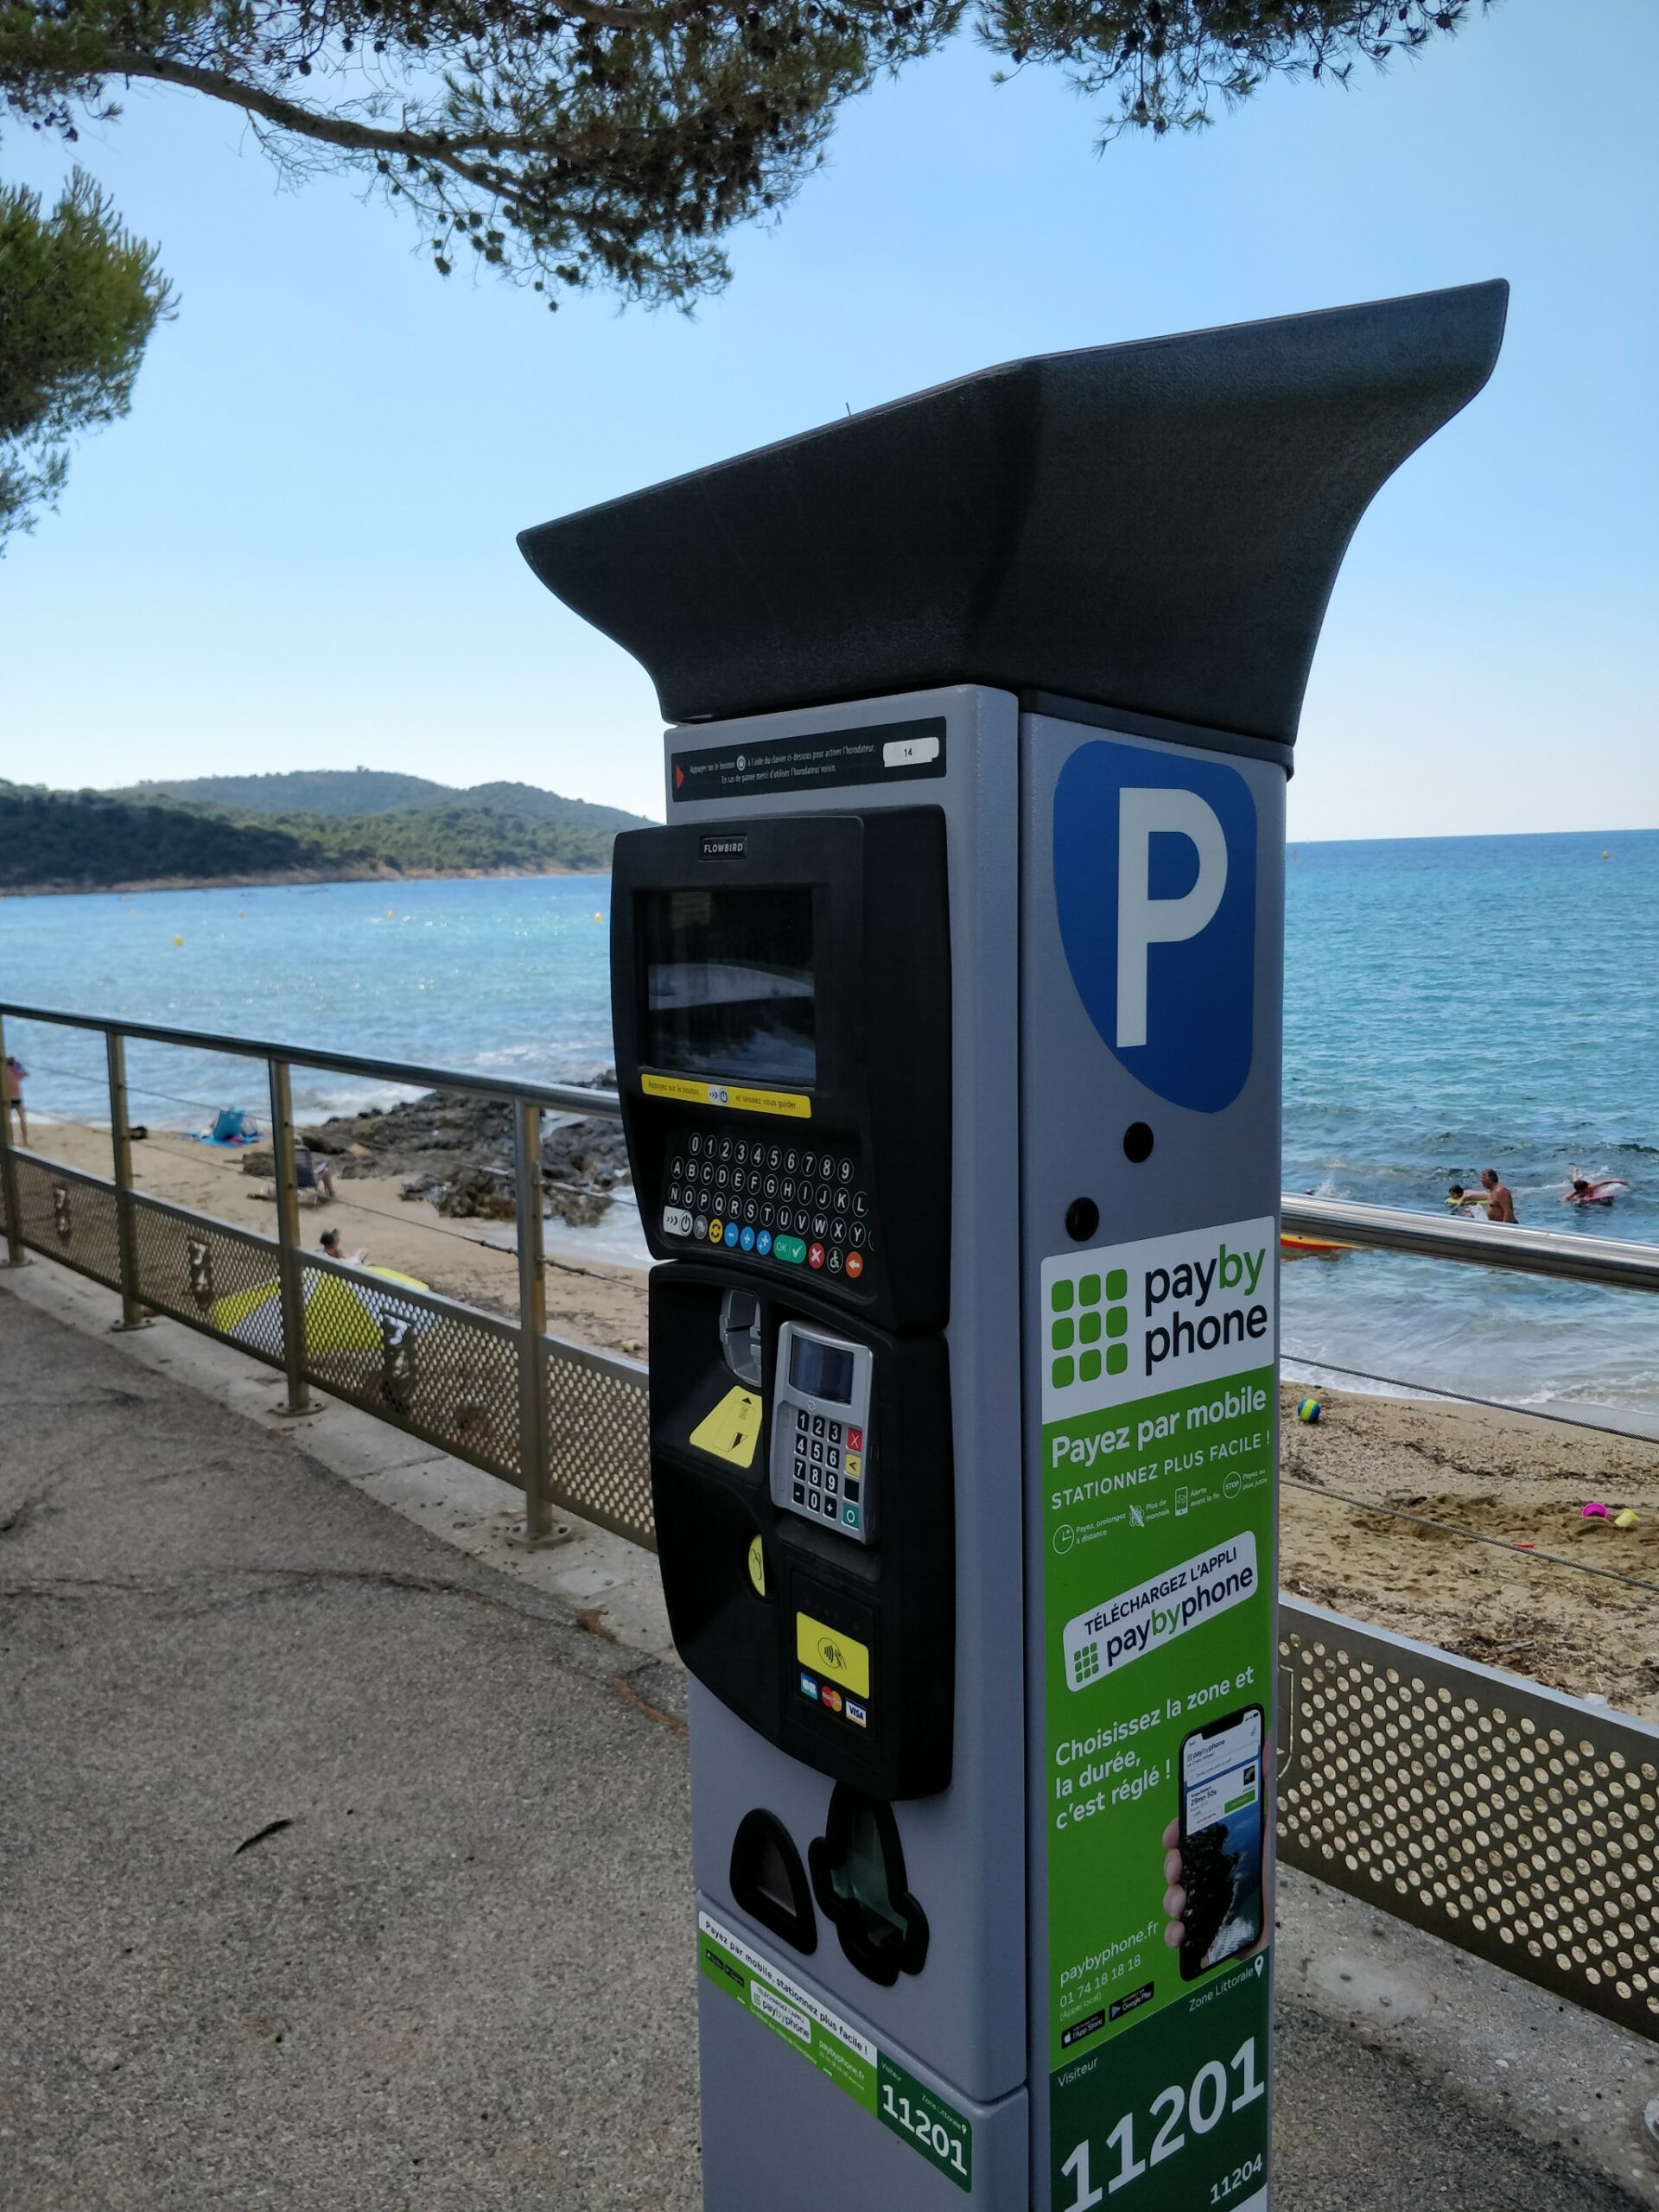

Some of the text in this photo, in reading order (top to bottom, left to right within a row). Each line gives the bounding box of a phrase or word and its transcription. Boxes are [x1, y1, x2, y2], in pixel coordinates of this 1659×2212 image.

[765, 756, 770, 765] du
[787, 750, 811, 762] ci-dessous
[812, 751, 823, 761] pour
[825, 747, 842, 758] activer
[903, 747, 912, 758] 14
[721, 775, 727, 784] En
[742, 773, 755, 784] panne
[756, 772, 769, 780] merci
[791, 765, 820, 777] l'horodateur
[703, 843, 743, 853] FLOWBIRD
[1116, 787, 1228, 1048] P
[735, 1093, 741, 1102] et
[743, 1093, 761, 1104] laissez
[763, 1097, 777, 1107] vous
[778, 1097, 796, 1110] guider
[692, 1136, 849, 1179] 0 1 2 3 4 5 6 7 8 9
[673, 1161, 863, 1211] A B C D E F G H I J K L
[671, 1187, 861, 1242] N O P Q R S T U V W X Y
[776, 1241, 787, 1253] OK
[1145, 1244, 1265, 1317] payby
[1145, 1305, 1268, 1376] phone
[800, 1414, 838, 1440] 1 2 3
[1051, 1386, 1266, 1468] Payez par mobile
[797, 1438, 836, 1465] 4 5 6
[796, 1461, 835, 1491] 7 8 9
[1051, 1464, 1159, 1510] STATIONNEZ
[1163, 1450, 1204, 1476] PLUS
[1210, 1436, 1262, 1463] FACILE
[1224, 1480, 1240, 1491] STOP
[1243, 1470, 1258, 1482] Payez
[1243, 1477, 1268, 1491] plus juste
[810, 1495, 817, 1510] 0
[1146, 1499, 1166, 1511] Plus de
[1190, 1486, 1207, 1498] Alerte
[1190, 1496, 1206, 1508] avant
[1076, 1512, 1126, 1535] Payez, prolongez
[1146, 1509, 1170, 1522] monnaie
[1081, 1529, 1107, 1543] distance
[1084, 1547, 1236, 1636] TÉLÉCHARGEZ L'APPLI
[1107, 1567, 1253, 1667] paybyphone
[849, 1706, 864, 1720] VISA
[1055, 1708, 1161, 1766] Choisissez
[1166, 1699, 1181, 1719] la
[1187, 1679, 1230, 1710] zone
[1236, 1665, 1254, 1689] et
[1193, 1738, 1226, 1759] paybyphone
[1056, 1751, 1141, 1799] la durée,
[1056, 1793, 1105, 1830] c'est
[1111, 1766, 1160, 1805] réglé
[1166, 1759, 1171, 1780] !
[1190, 1793, 1207, 1808] 29mn
[1207, 1789, 1217, 1802] 50s
[1060, 1921, 1159, 1987] paybyphone.fr
[705, 1920, 728, 1944] Payez
[730, 1939, 743, 1955] par
[745, 1952, 775, 1984] mobile,
[776, 1976, 818, 2016] stationnez
[820, 2012, 837, 2032] plus
[839, 2025, 862, 2053] facile
[1059, 1955, 1141, 2008] 01 74 18 18 18
[1189, 1968, 1253, 2012] Zone Littorale
[1083, 1992, 1102, 2010] local)
[1122, 1997, 1142, 2012] Google
[1143, 1991, 1152, 2004] Play
[762, 1999, 810, 2040] paybyphone
[1087, 2018, 1103, 2032] Store
[819, 2040, 865, 2081] paybyphone.fr
[881, 2061, 902, 2082] Visiteur
[1058, 2057, 1098, 2088] Visiteur
[921, 2094, 962, 2131] Zone Littorale
[1061, 2037, 1264, 2212] 11201
[882, 2084, 967, 2176] 11201
[1211, 2153, 1262, 2204] 11204
